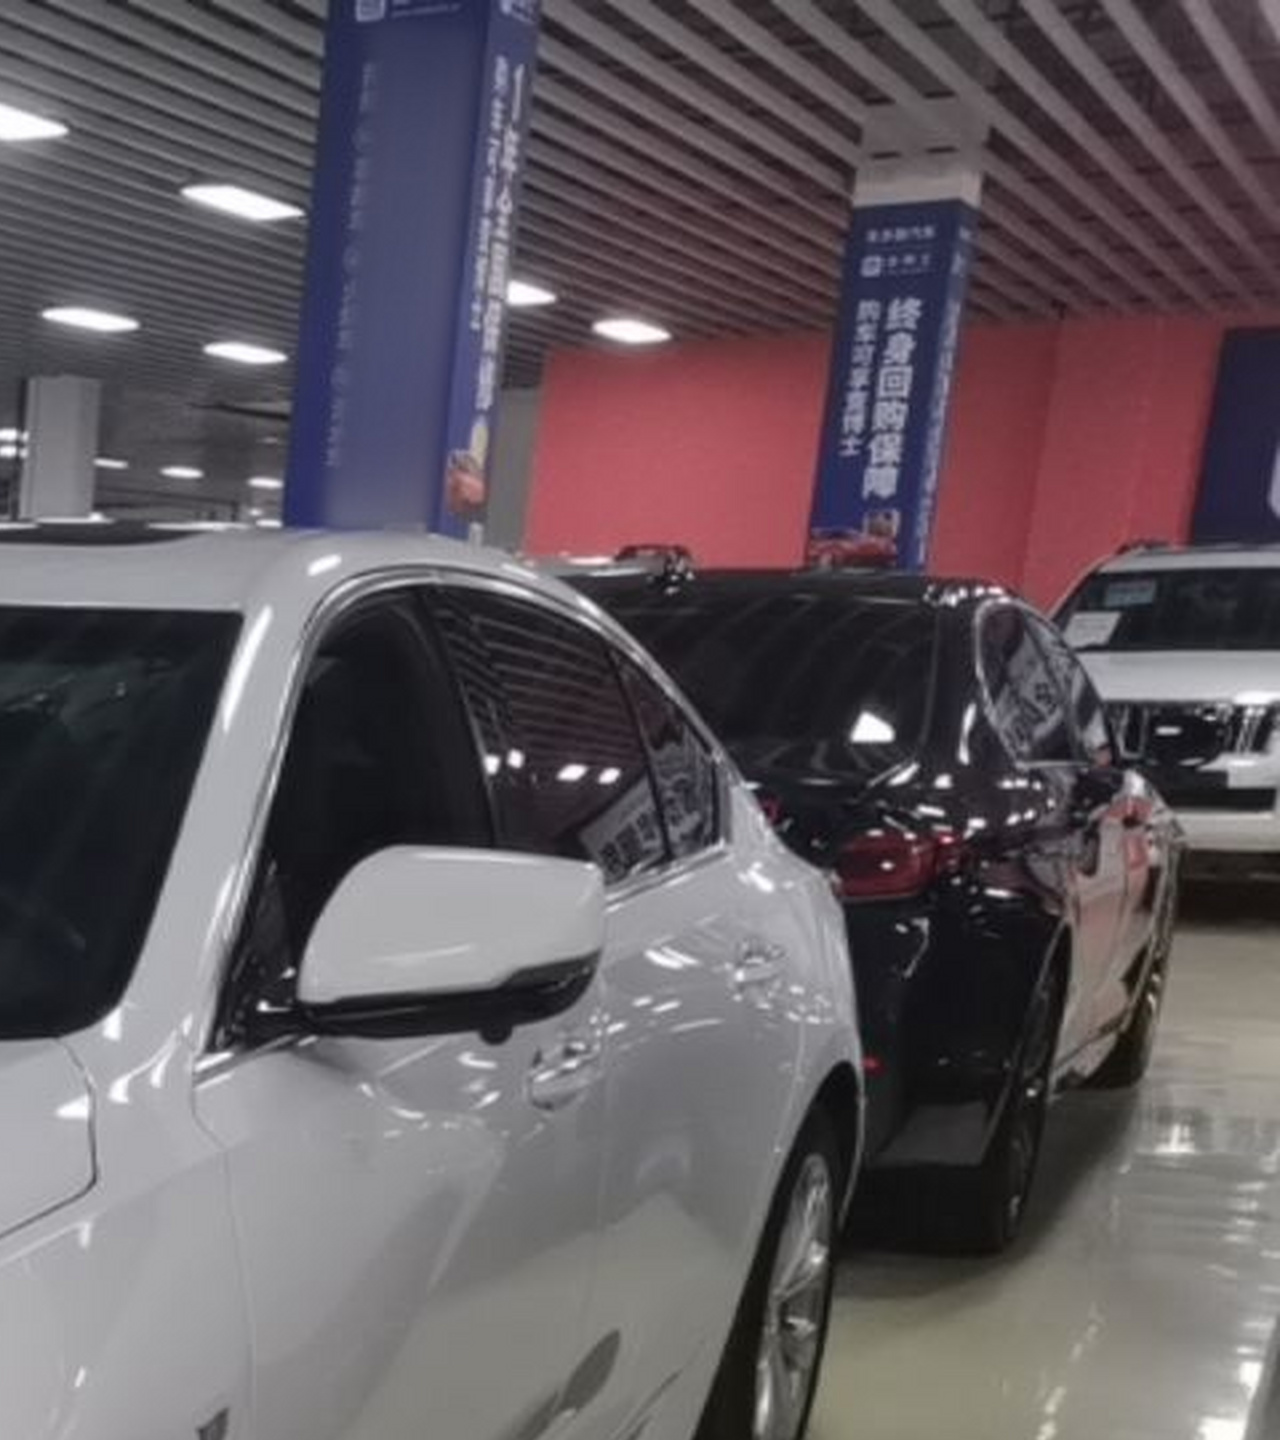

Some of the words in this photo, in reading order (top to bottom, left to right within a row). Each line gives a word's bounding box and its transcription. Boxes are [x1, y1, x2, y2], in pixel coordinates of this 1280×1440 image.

[862, 297, 922, 500] 终身回购保障
